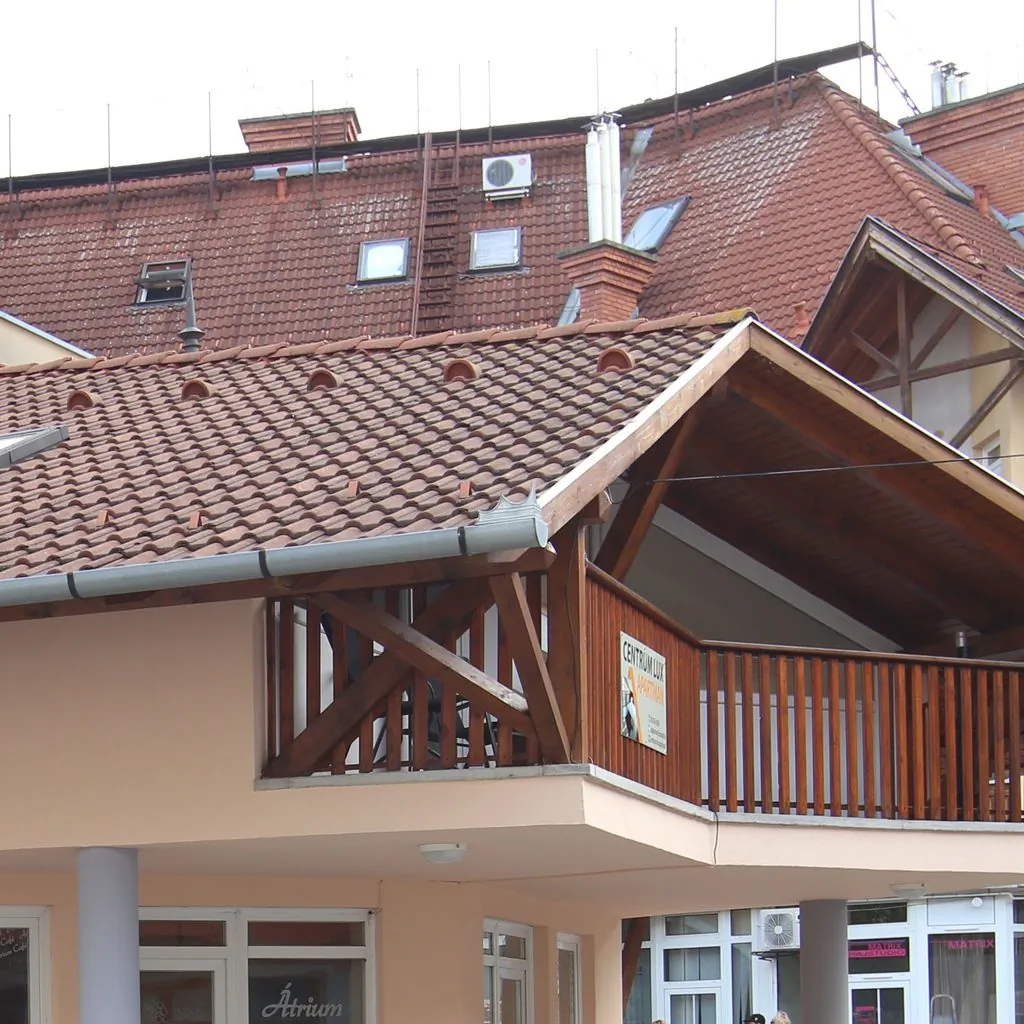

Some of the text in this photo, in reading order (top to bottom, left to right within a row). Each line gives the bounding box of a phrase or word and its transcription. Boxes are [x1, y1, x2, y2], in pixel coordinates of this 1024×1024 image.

[623, 641, 664, 682] CENTRUM LUX
[948, 939, 993, 949] MATRIX
[262, 982, 344, 1018] Átrium
